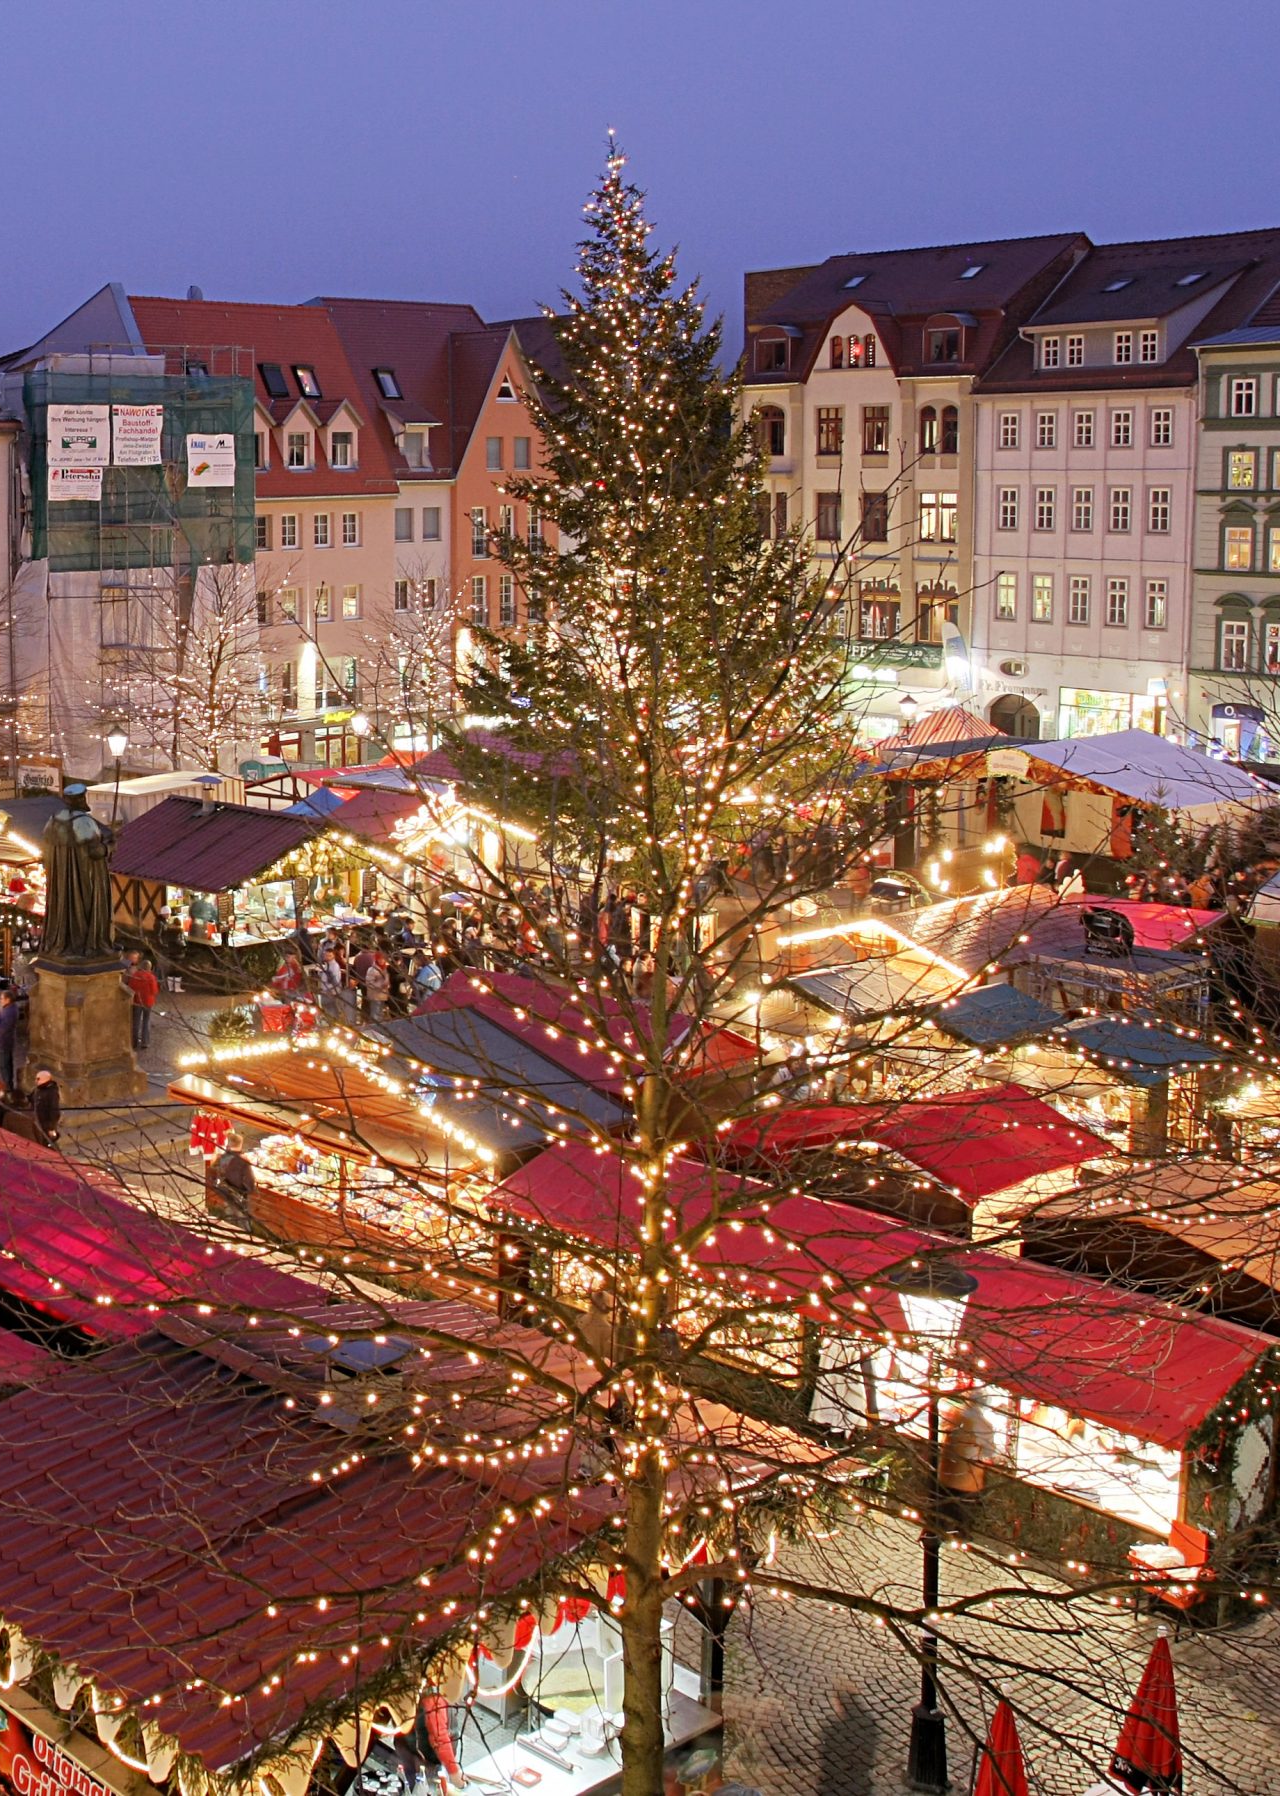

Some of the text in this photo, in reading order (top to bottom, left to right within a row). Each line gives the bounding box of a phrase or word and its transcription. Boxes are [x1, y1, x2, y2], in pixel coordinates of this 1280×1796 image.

[120, 408, 155, 417] NAWOTKE
[122, 419, 154, 427] Baustoff-
[118, 427, 159, 435] Fachhandel
[61, 469, 100, 480] Petersohn
